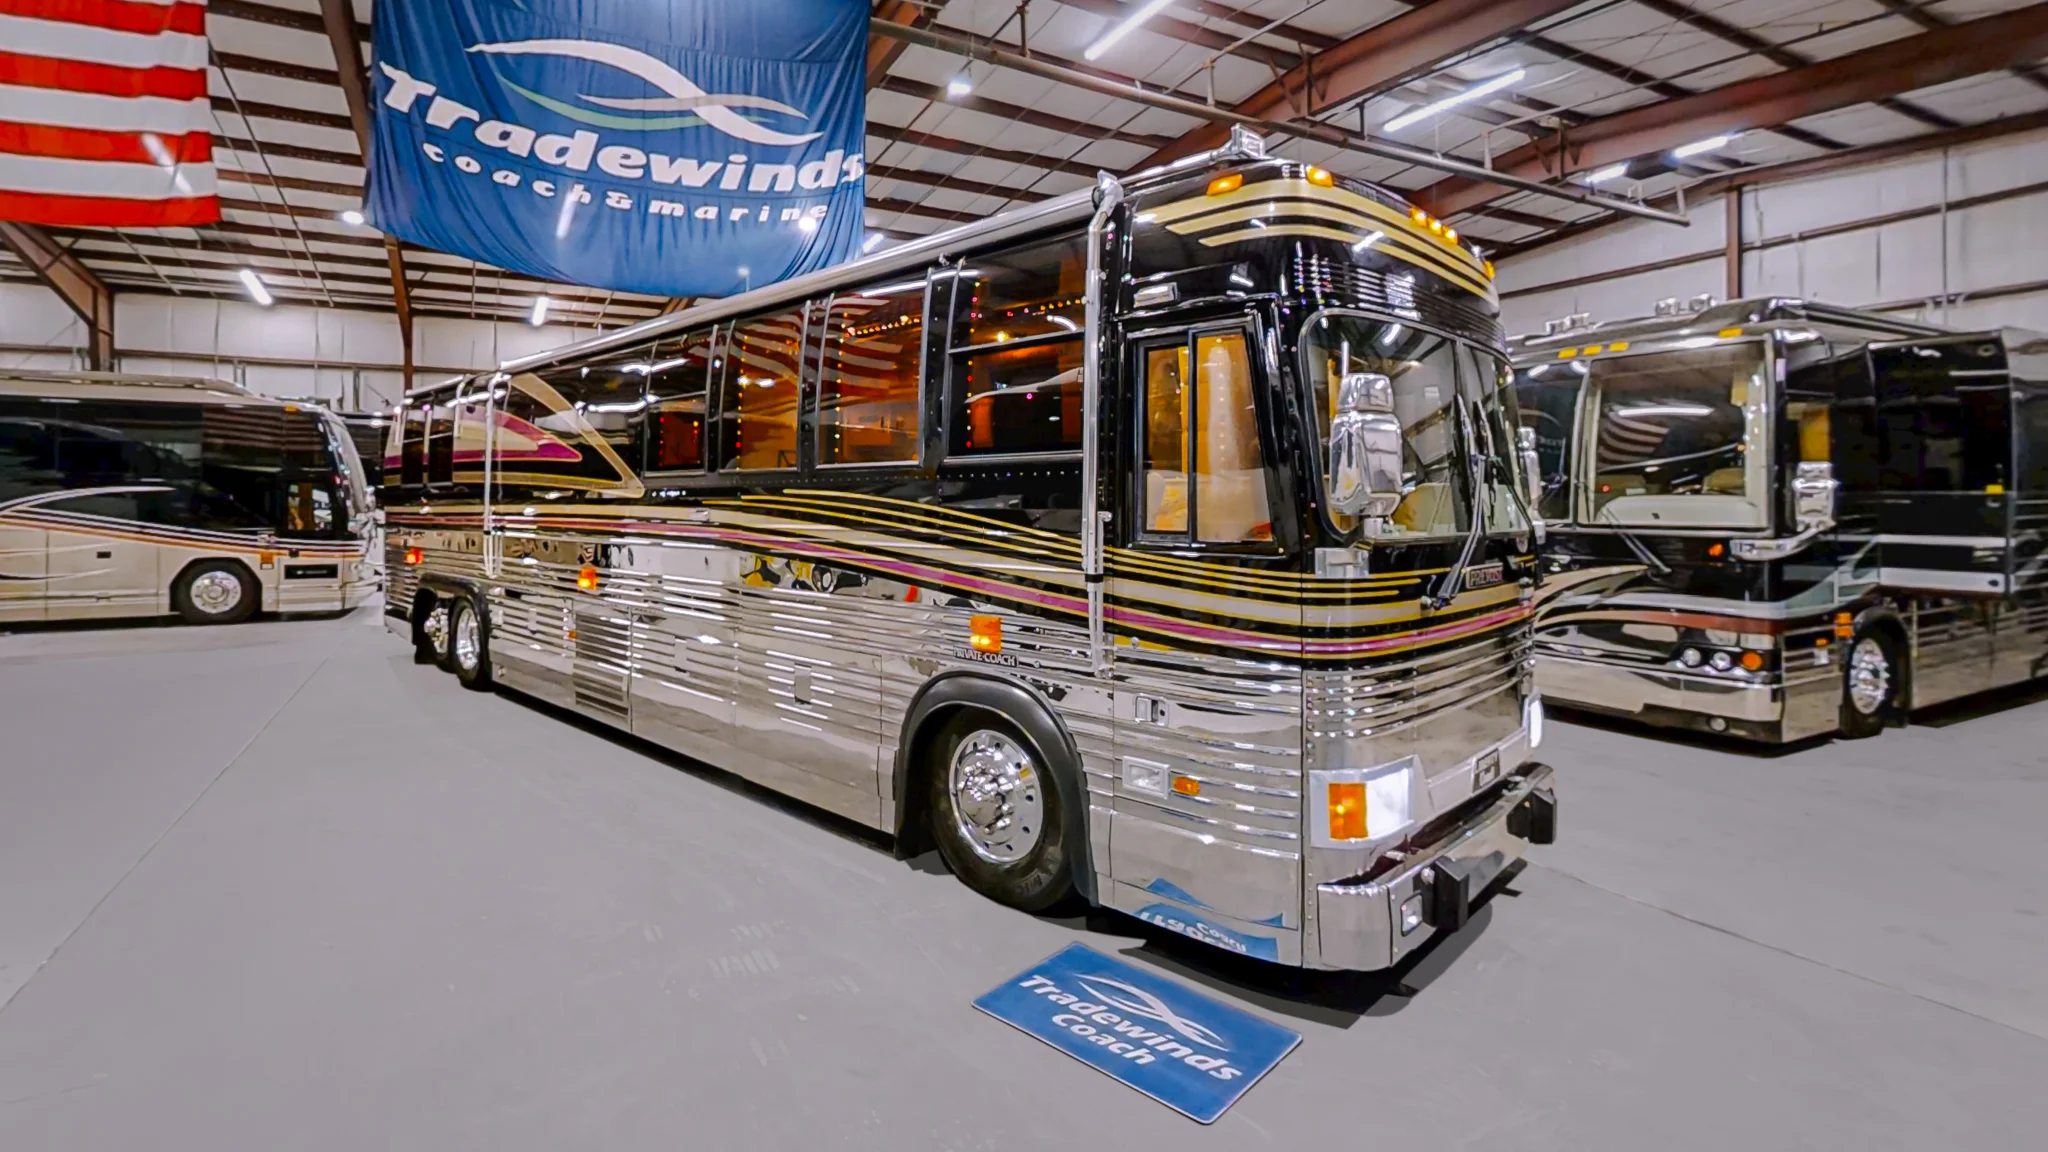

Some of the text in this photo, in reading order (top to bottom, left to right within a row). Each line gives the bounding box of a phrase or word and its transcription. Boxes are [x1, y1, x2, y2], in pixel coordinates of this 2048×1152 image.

[379, 61, 864, 193] Tradewinds
[1018, 975, 1244, 1081] Tradewinds
[1051, 1013, 1157, 1066] Coach
